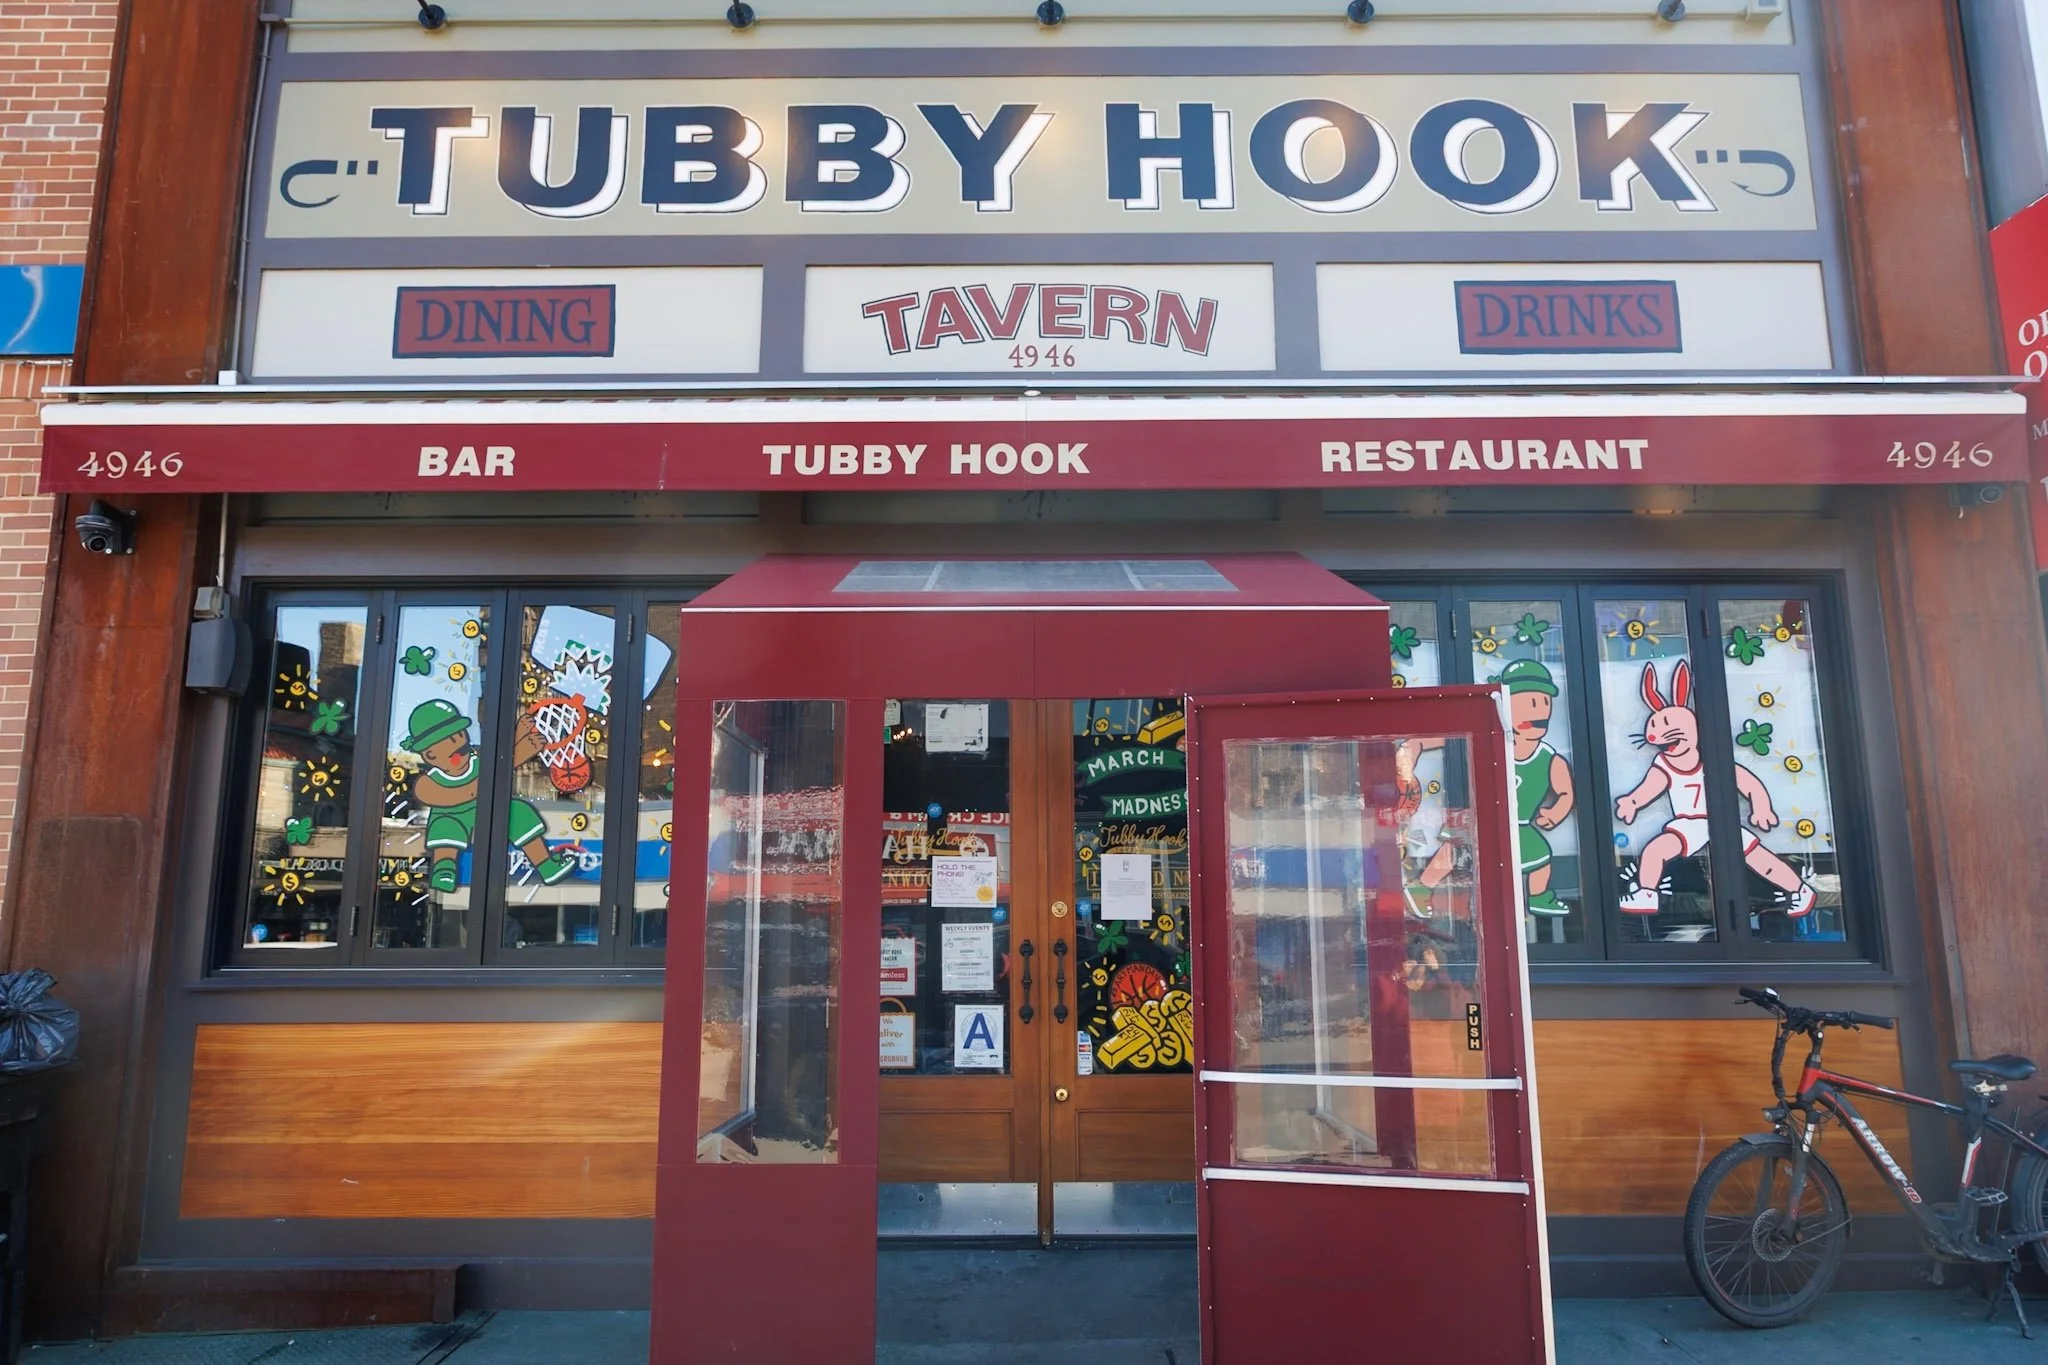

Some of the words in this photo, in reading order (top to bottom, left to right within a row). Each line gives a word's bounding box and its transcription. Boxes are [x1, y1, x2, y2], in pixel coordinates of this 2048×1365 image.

[369, 102, 1056, 220] TUBBY
[1104, 97, 1719, 214] HOOK
[414, 296, 595, 345] DINING
[861, 281, 1219, 357] TAVERN
[1472, 291, 1665, 340] DRINKS
[1008, 343, 1077, 369] 4946
[76, 449, 184, 480] 4946
[416, 445, 517, 478] BAR
[761, 442, 928, 476] TUBBY
[949, 442, 1091, 475] HOOK
[1319, 437, 1650, 473] RESTAURANT
[1885, 439, 1995, 469] 4946
[1087, 749, 1165, 778] MARCH
[1683, 783, 1702, 809] 7
[1100, 823, 1145, 850] Tubby
[1144, 825, 1187, 848] Hook
[880, 970, 905, 979] amless
[963, 1013, 995, 1049] A
[1468, 1004, 1480, 1049] PUSH
